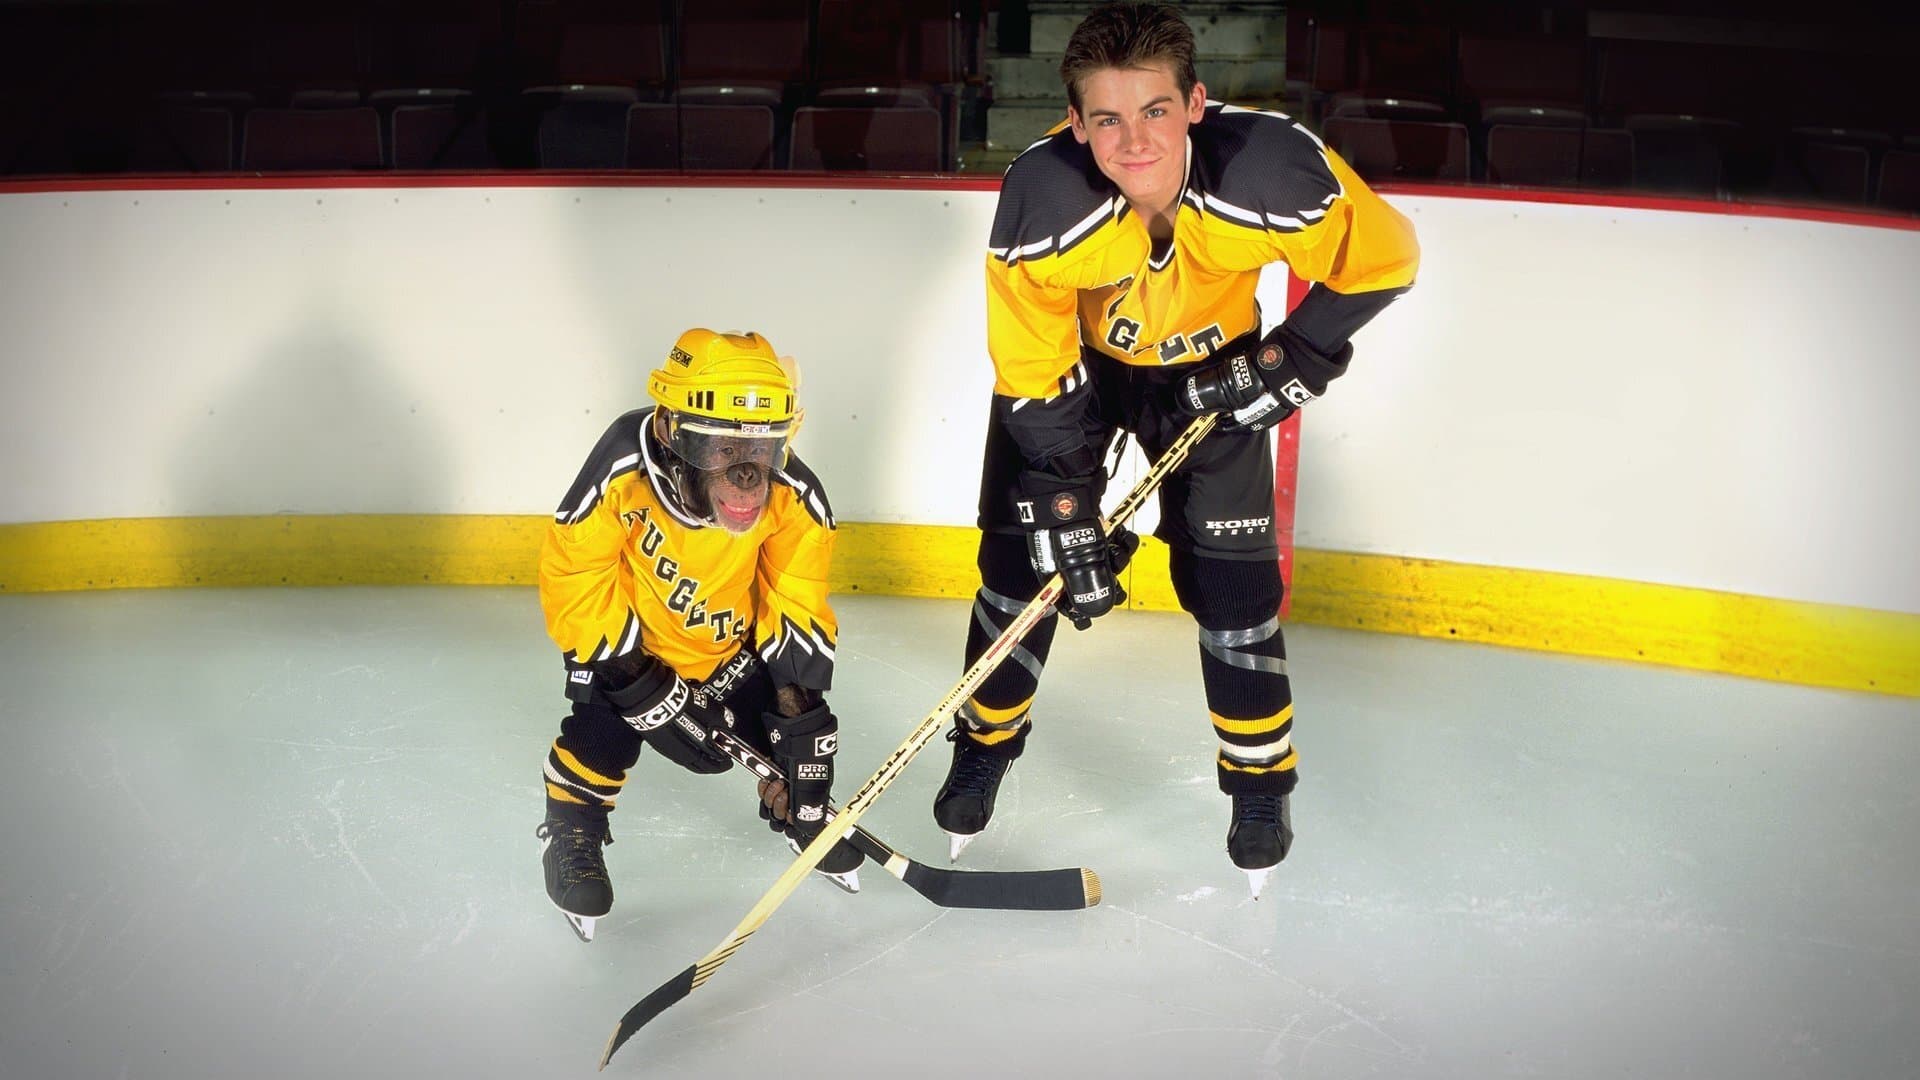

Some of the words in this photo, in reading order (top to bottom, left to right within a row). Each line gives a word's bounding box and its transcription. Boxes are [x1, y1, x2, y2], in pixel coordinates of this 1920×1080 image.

[1109, 427, 1199, 526] TITAN
[1206, 519, 1269, 530] KOHO
[678, 715, 705, 741] CCM
[801, 765, 826, 773] PRO
[848, 748, 907, 812] TITAN
